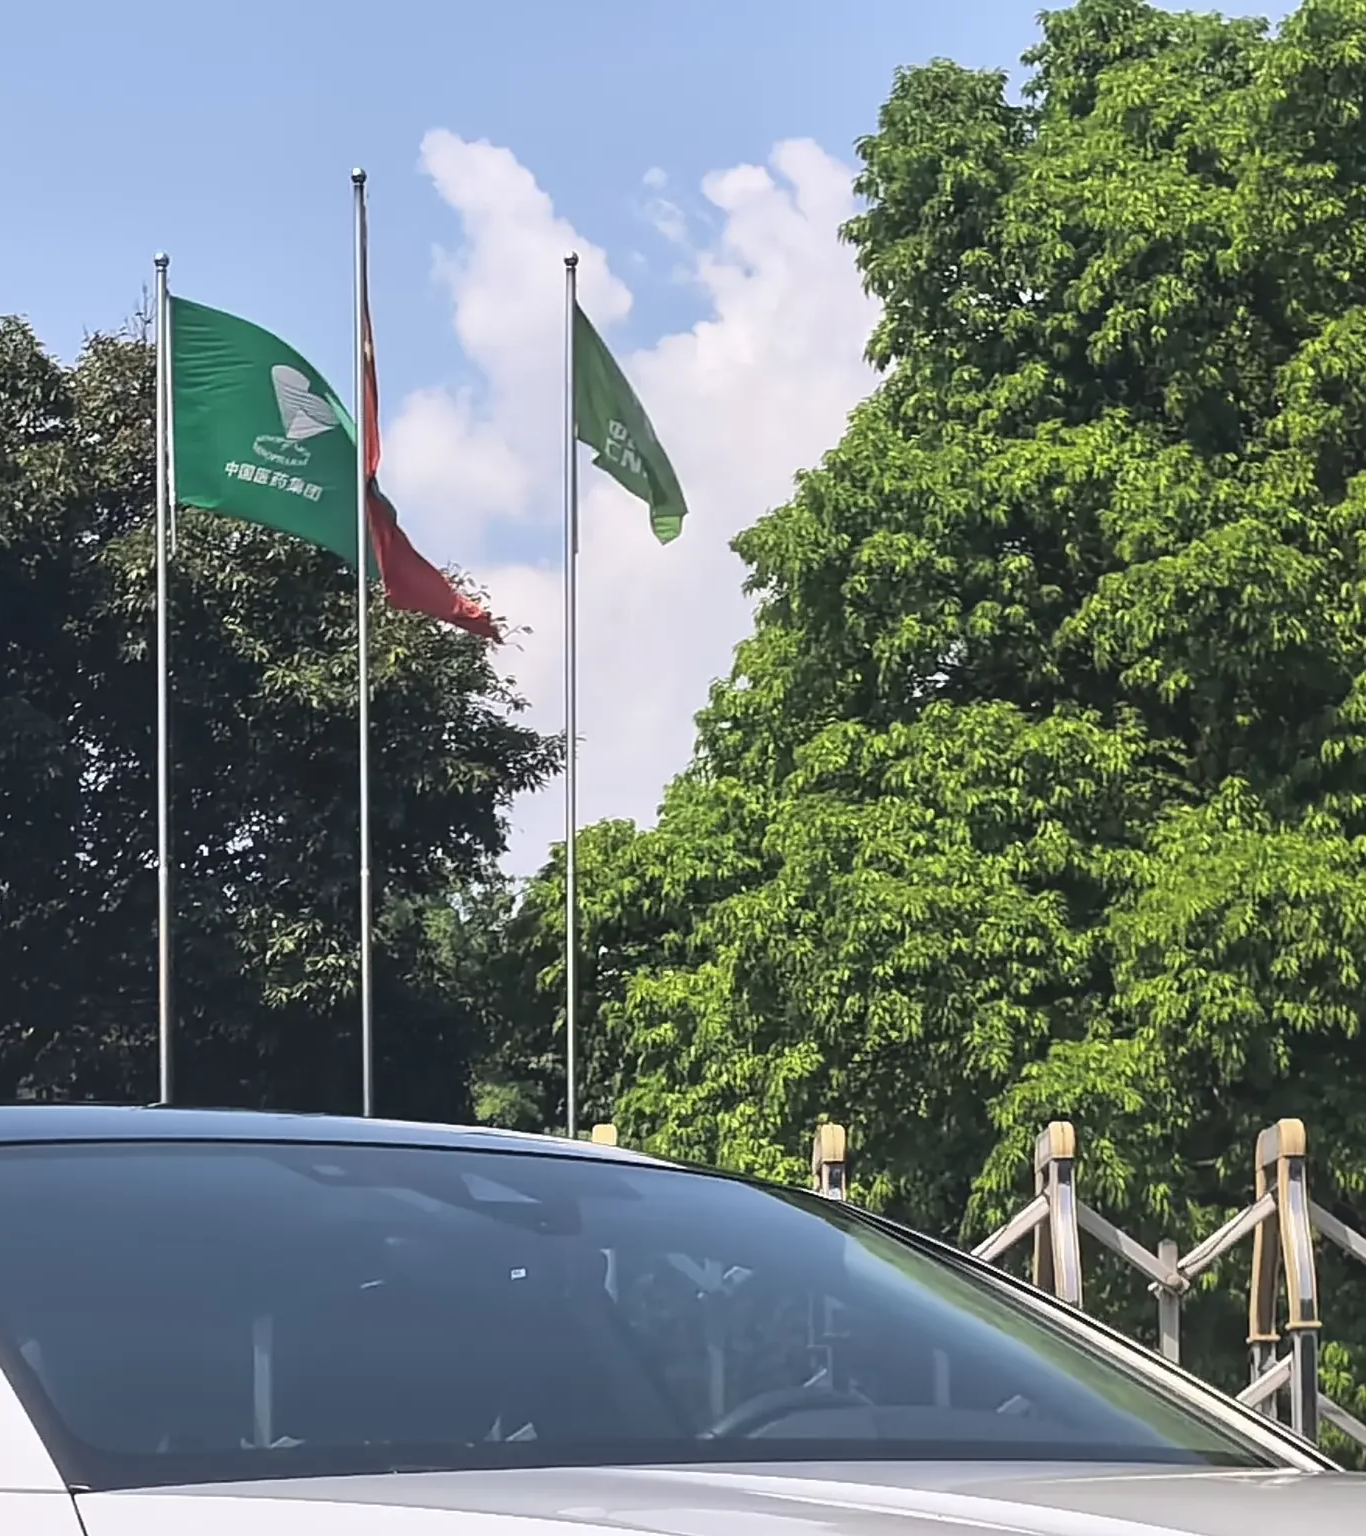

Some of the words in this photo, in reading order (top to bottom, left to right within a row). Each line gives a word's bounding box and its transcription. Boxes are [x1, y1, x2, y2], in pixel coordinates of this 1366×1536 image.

[225, 461, 323, 502] 中国医药集团
